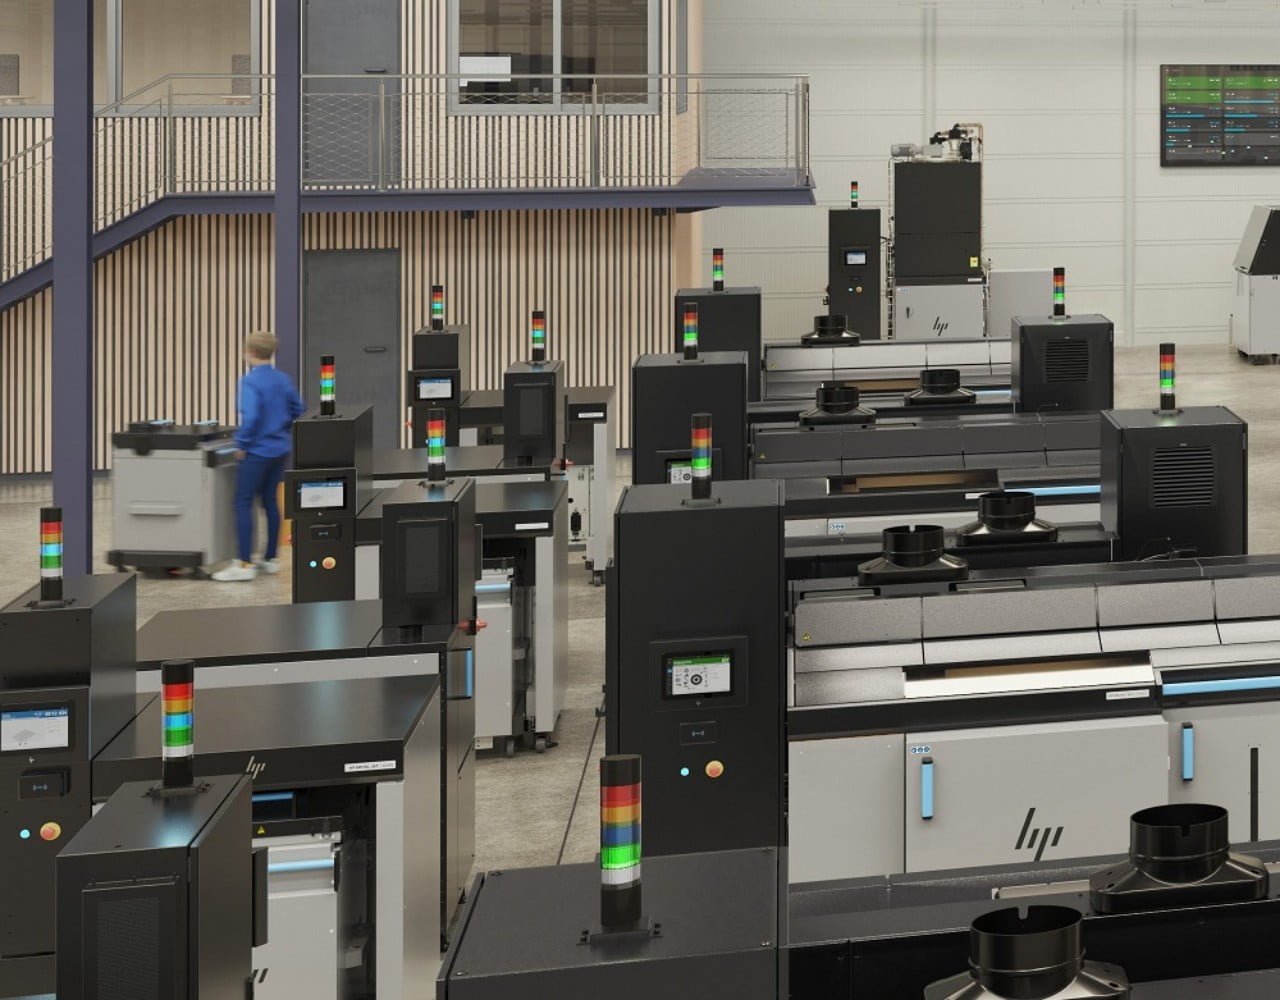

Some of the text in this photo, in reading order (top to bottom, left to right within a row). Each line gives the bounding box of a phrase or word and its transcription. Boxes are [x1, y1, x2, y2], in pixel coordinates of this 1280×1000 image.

[933, 316, 949, 336] hp
[246, 755, 266, 779] hp
[1015, 807, 1064, 862] hp
